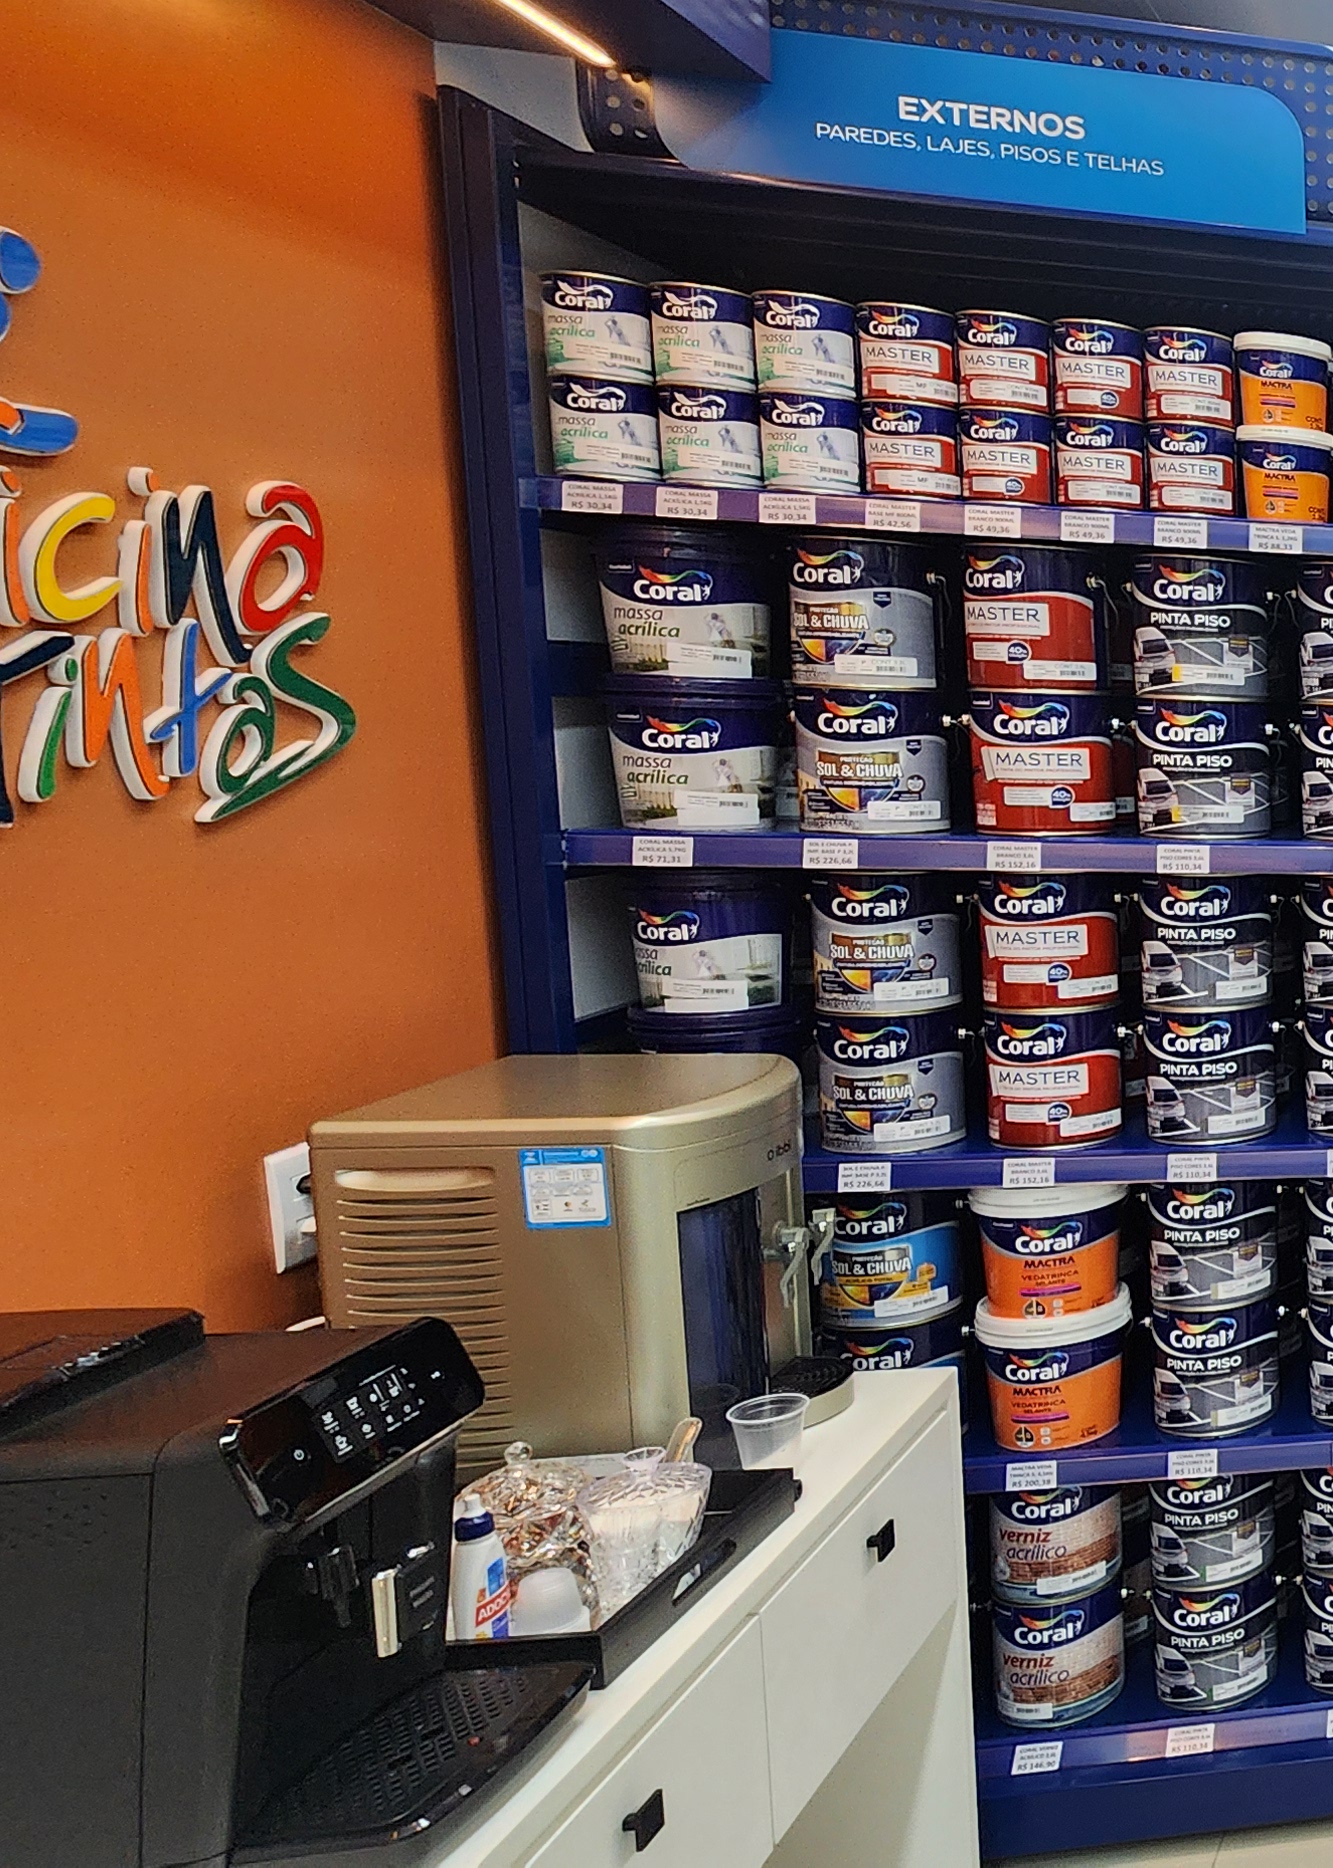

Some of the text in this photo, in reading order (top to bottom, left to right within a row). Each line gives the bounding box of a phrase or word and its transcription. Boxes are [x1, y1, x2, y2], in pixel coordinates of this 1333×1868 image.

[898, 96, 1086, 140] EXTERNOS
[815, 123, 1164, 177] PAREDES, LAJES, PISOS E TELHAS
[868, 320, 917, 337] Coral
[866, 346, 932, 364] MASTER
[1260, 366, 1291, 379] Coral
[566, 393, 624, 412] Coral
[558, 416, 596, 427] massa
[634, 579, 702, 602] Coral
[1154, 580, 1217, 602] Coral
[614, 606, 663, 621] massa
[1151, 612, 1231, 629] PINTA PISO
[618, 620, 680, 638] acrílica
[818, 713, 886, 734] Coral
[994, 714, 1059, 736] Coral
[995, 751, 1083, 767] MASTER
[817, 760, 839, 778] SOL
[840, 762, 854, 778] &
[856, 761, 903, 779] CHUVA
[809, 856, 823, 865] R$
[995, 860, 1006, 869] R$
[831, 897, 898, 918] Coral
[1161, 896, 1222, 917] Coral
[1158, 926, 1236, 941] PINTA PISO
[830, 944, 914, 959] SOL & CHUVA
[1014, 1233, 1074, 1254] Coral
[1023, 1256, 1076, 1269] MACTRA
[1174, 1606, 1230, 1626] Coral
[1015, 1625, 1073, 1645] Coral
[1170, 1628, 1246, 1649] PINTA PISO
[1003, 1652, 1054, 1669] verniz
[1010, 1667, 1069, 1686] acrílico
